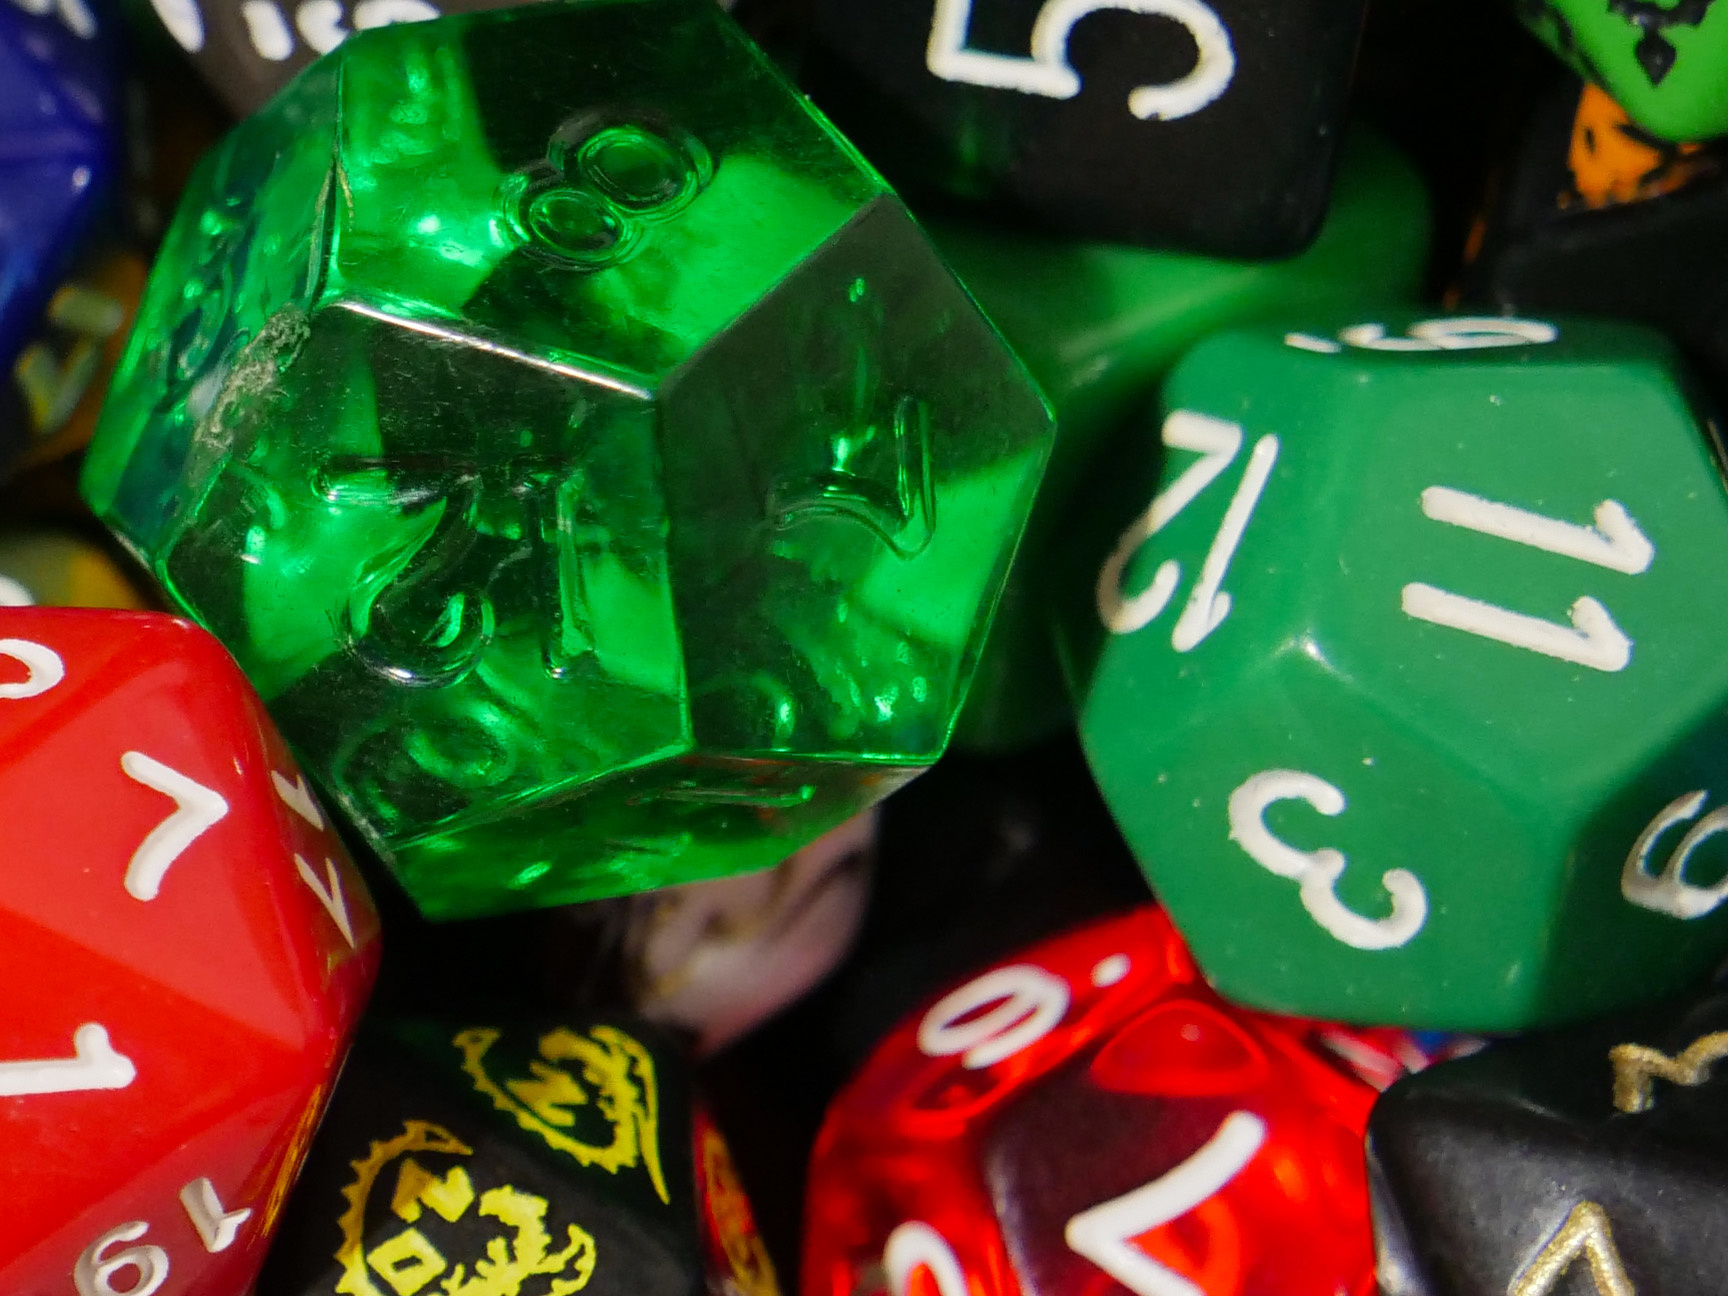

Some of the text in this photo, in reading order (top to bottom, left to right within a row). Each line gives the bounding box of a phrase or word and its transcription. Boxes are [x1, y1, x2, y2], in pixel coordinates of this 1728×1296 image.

[1095, 408, 1280, 654] 12
[1398, 484, 1656, 674] 11
[118, 748, 231, 904] 7
[1226, 767, 1431, 952] 3
